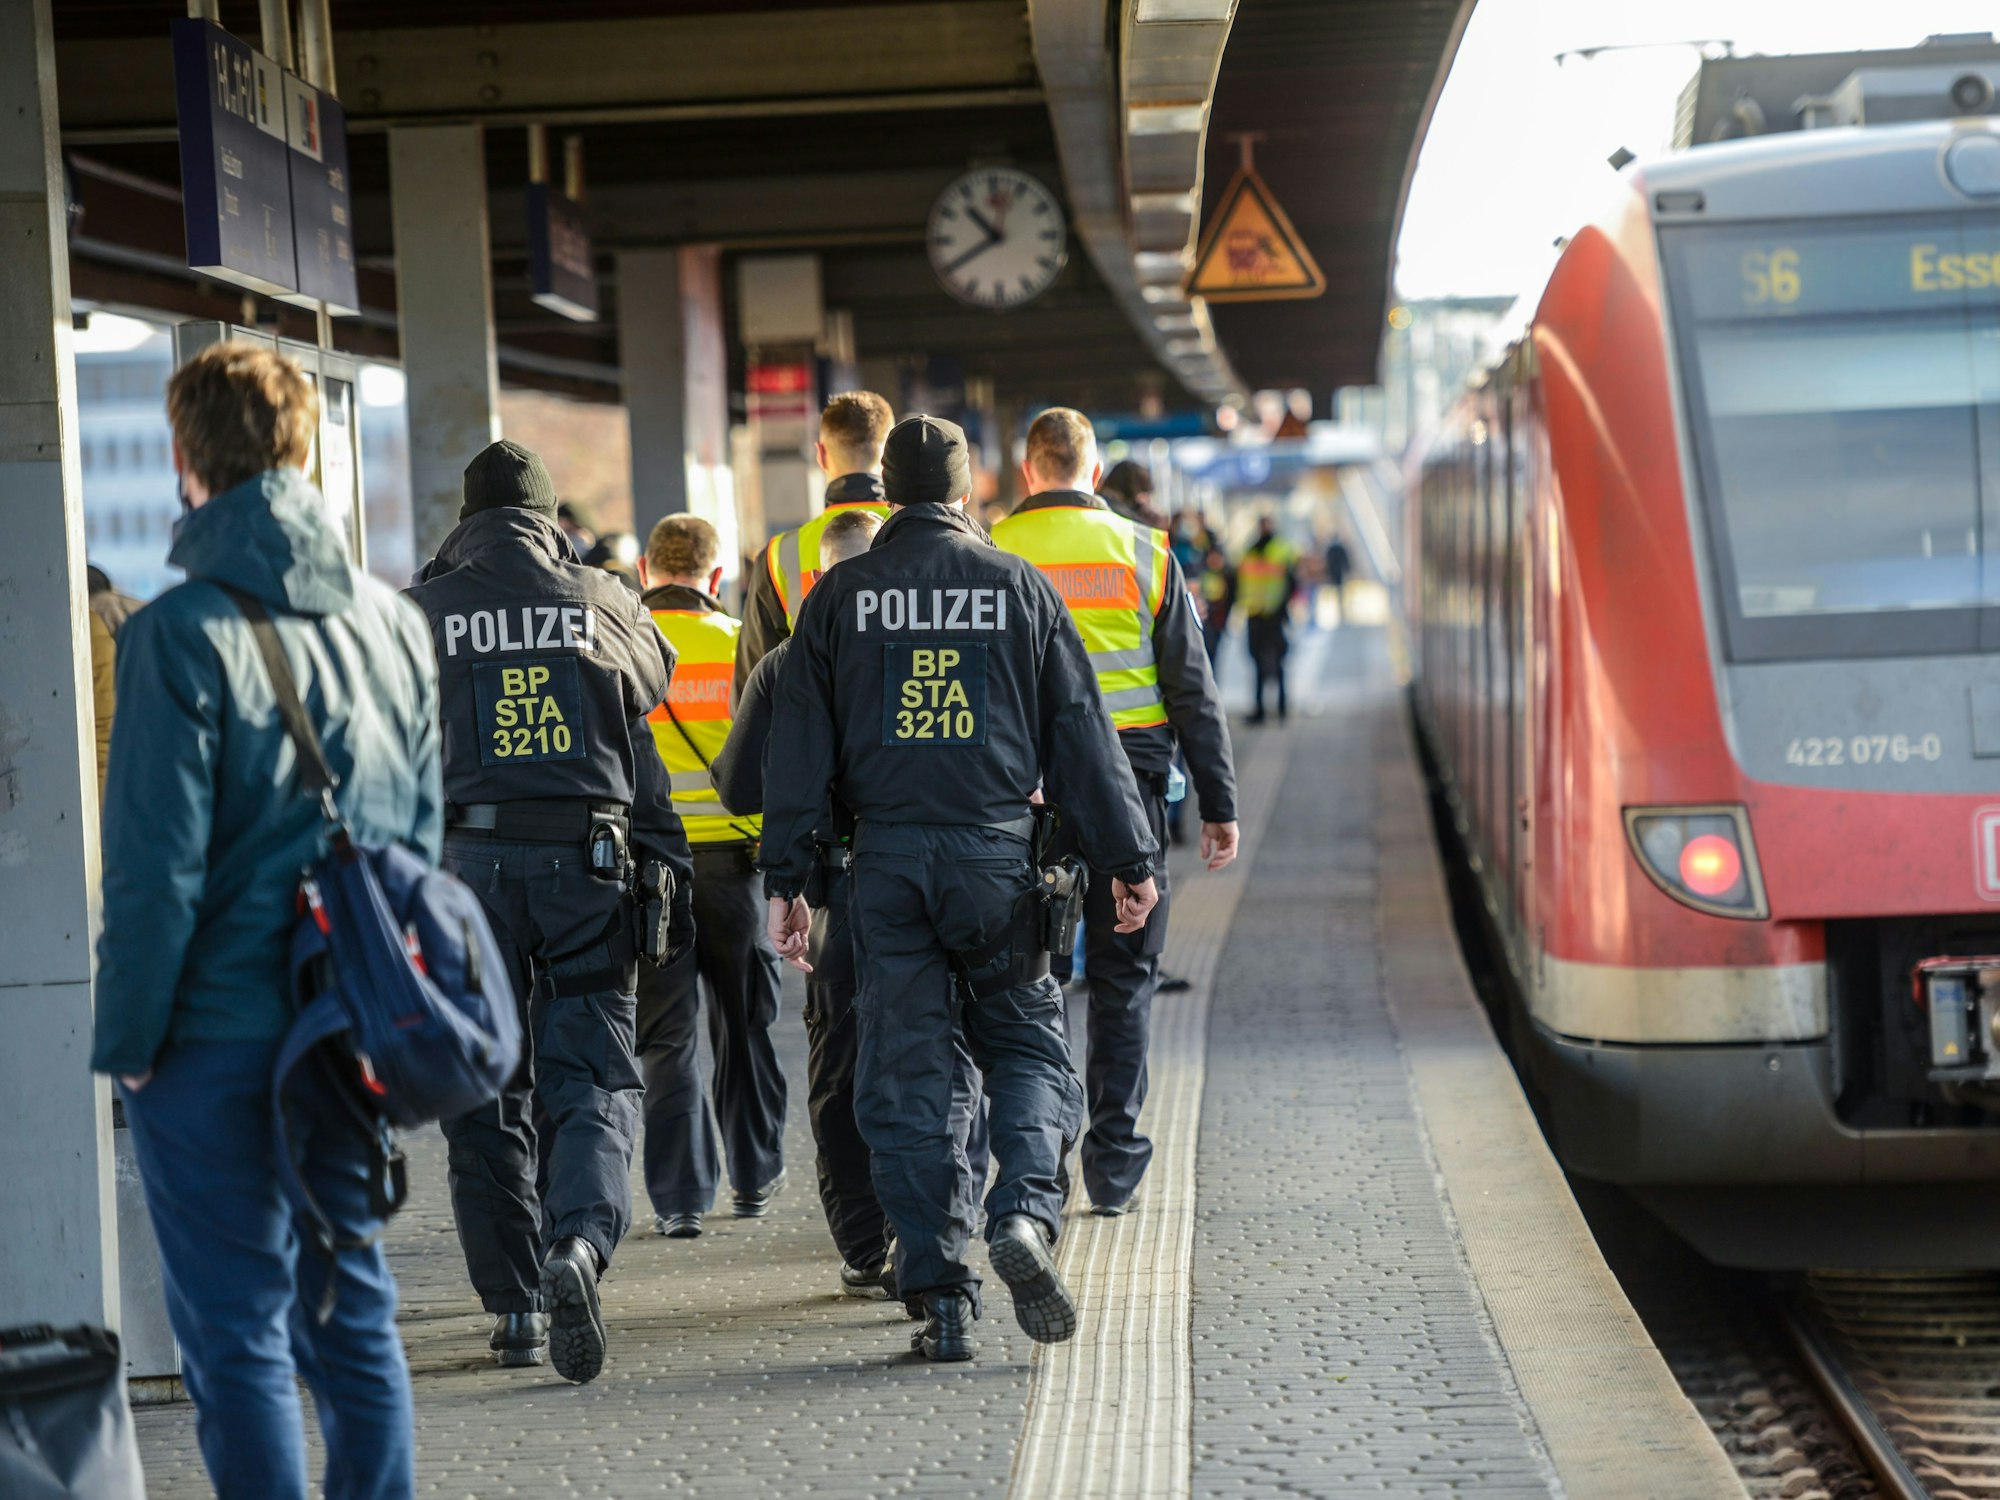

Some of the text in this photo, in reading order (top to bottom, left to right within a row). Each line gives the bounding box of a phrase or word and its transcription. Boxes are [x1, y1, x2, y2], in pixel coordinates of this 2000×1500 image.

[1741, 248, 1801, 304] S6
[1046, 568, 1125, 599] UNGSAMT
[856, 588, 1007, 632] POLIZEI
[444, 607, 595, 656] POLIZEI
[912, 649, 960, 677] BP
[502, 666, 550, 697] BP
[900, 679, 969, 708] STA
[495, 696, 564, 727] STA
[895, 710, 974, 739] 3210
[492, 725, 572, 758] 3210
[1785, 732, 1942, 767] 422 076-0
